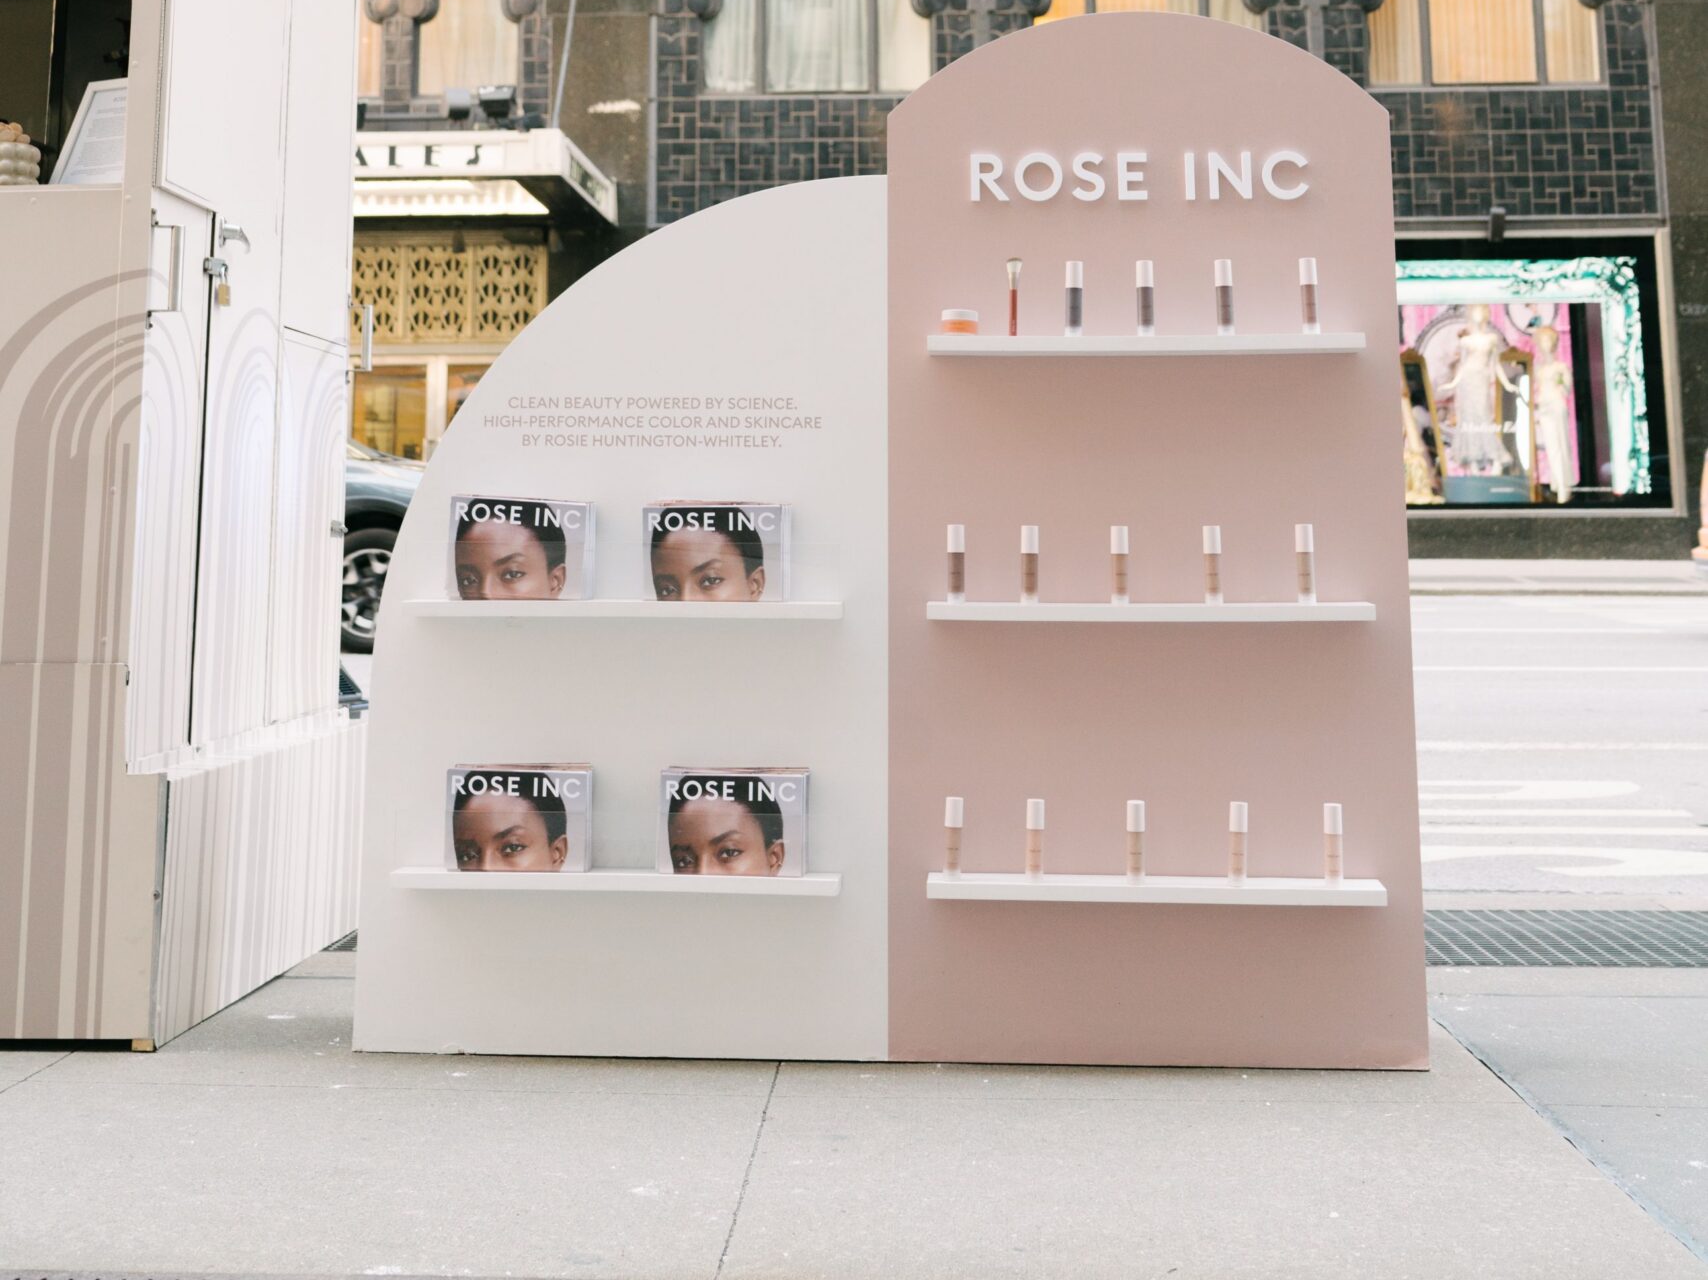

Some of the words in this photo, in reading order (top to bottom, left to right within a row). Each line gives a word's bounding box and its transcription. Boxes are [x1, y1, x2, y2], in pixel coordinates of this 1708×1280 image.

[969, 151, 1149, 202] ROSE
[1183, 150, 1310, 201] INC
[507, 396, 560, 409] CLEAN
[564, 396, 623, 410] BEAUTY
[626, 396, 701, 410] POWERED
[705, 397, 724, 410] BY
[727, 397, 798, 411] SCIENCE.
[483, 415, 644, 429] HIGH-PERFORMANCE
[648, 415, 703, 429] COLOR
[705, 415, 741, 429] AND
[744, 415, 822, 430] SKINCARE
[521, 433, 542, 447] BY
[544, 433, 588, 447] ROSIE
[592, 434, 783, 448] HUNTINGTON-WHITELEY.
[454, 502, 523, 525] ROSE
[534, 507, 581, 529] INC
[647, 511, 716, 532] ROSE
[728, 511, 776, 532] INC
[451, 775, 520, 797] ROSE
[533, 777, 581, 798] INC
[665, 780, 735, 801] ROSE
[748, 781, 797, 802] INC
